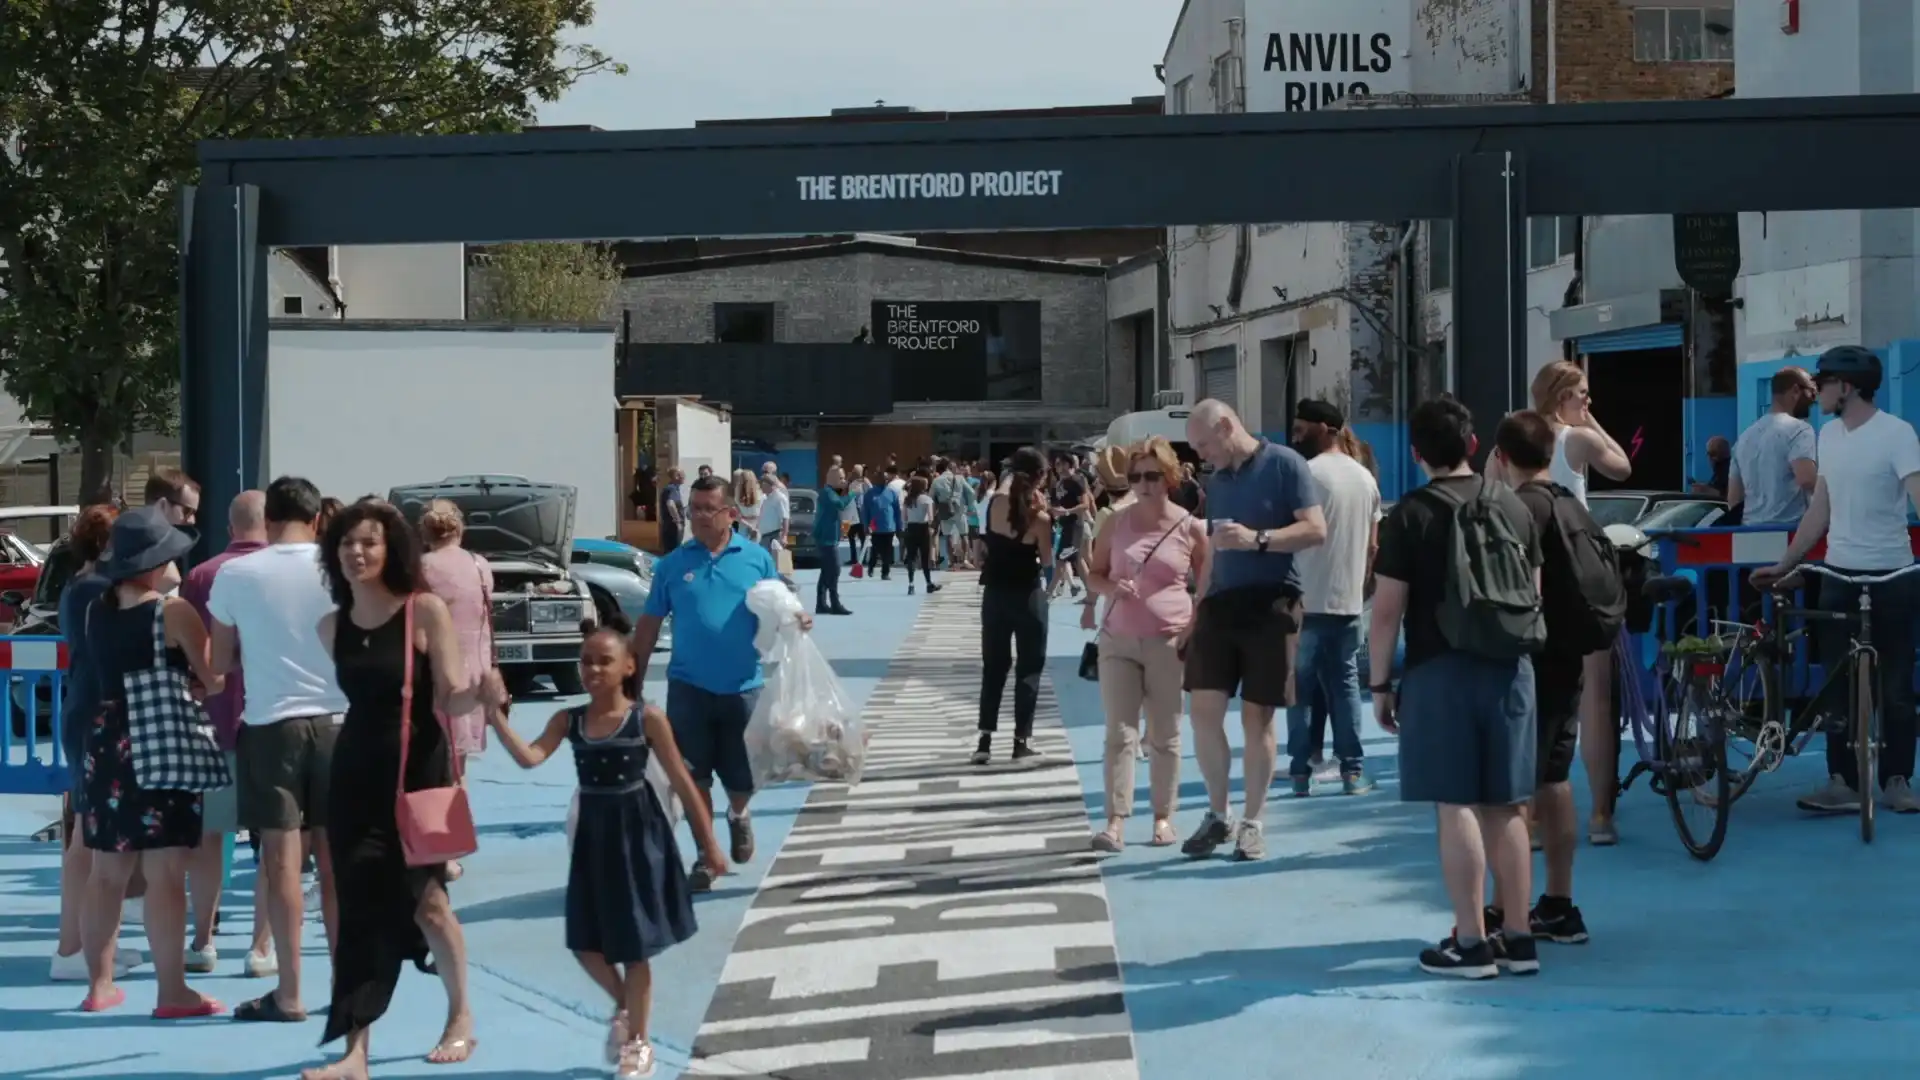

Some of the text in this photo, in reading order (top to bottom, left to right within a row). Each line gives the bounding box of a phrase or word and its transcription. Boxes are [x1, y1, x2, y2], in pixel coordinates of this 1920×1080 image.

[1263, 32, 1392, 73] ANVILS
[796, 170, 1062, 200] THE BRENTFORD PROJECT
[887, 304, 918, 319] THE
[887, 320, 980, 334] BRENTFORD
[888, 336, 958, 350] PROJECT
